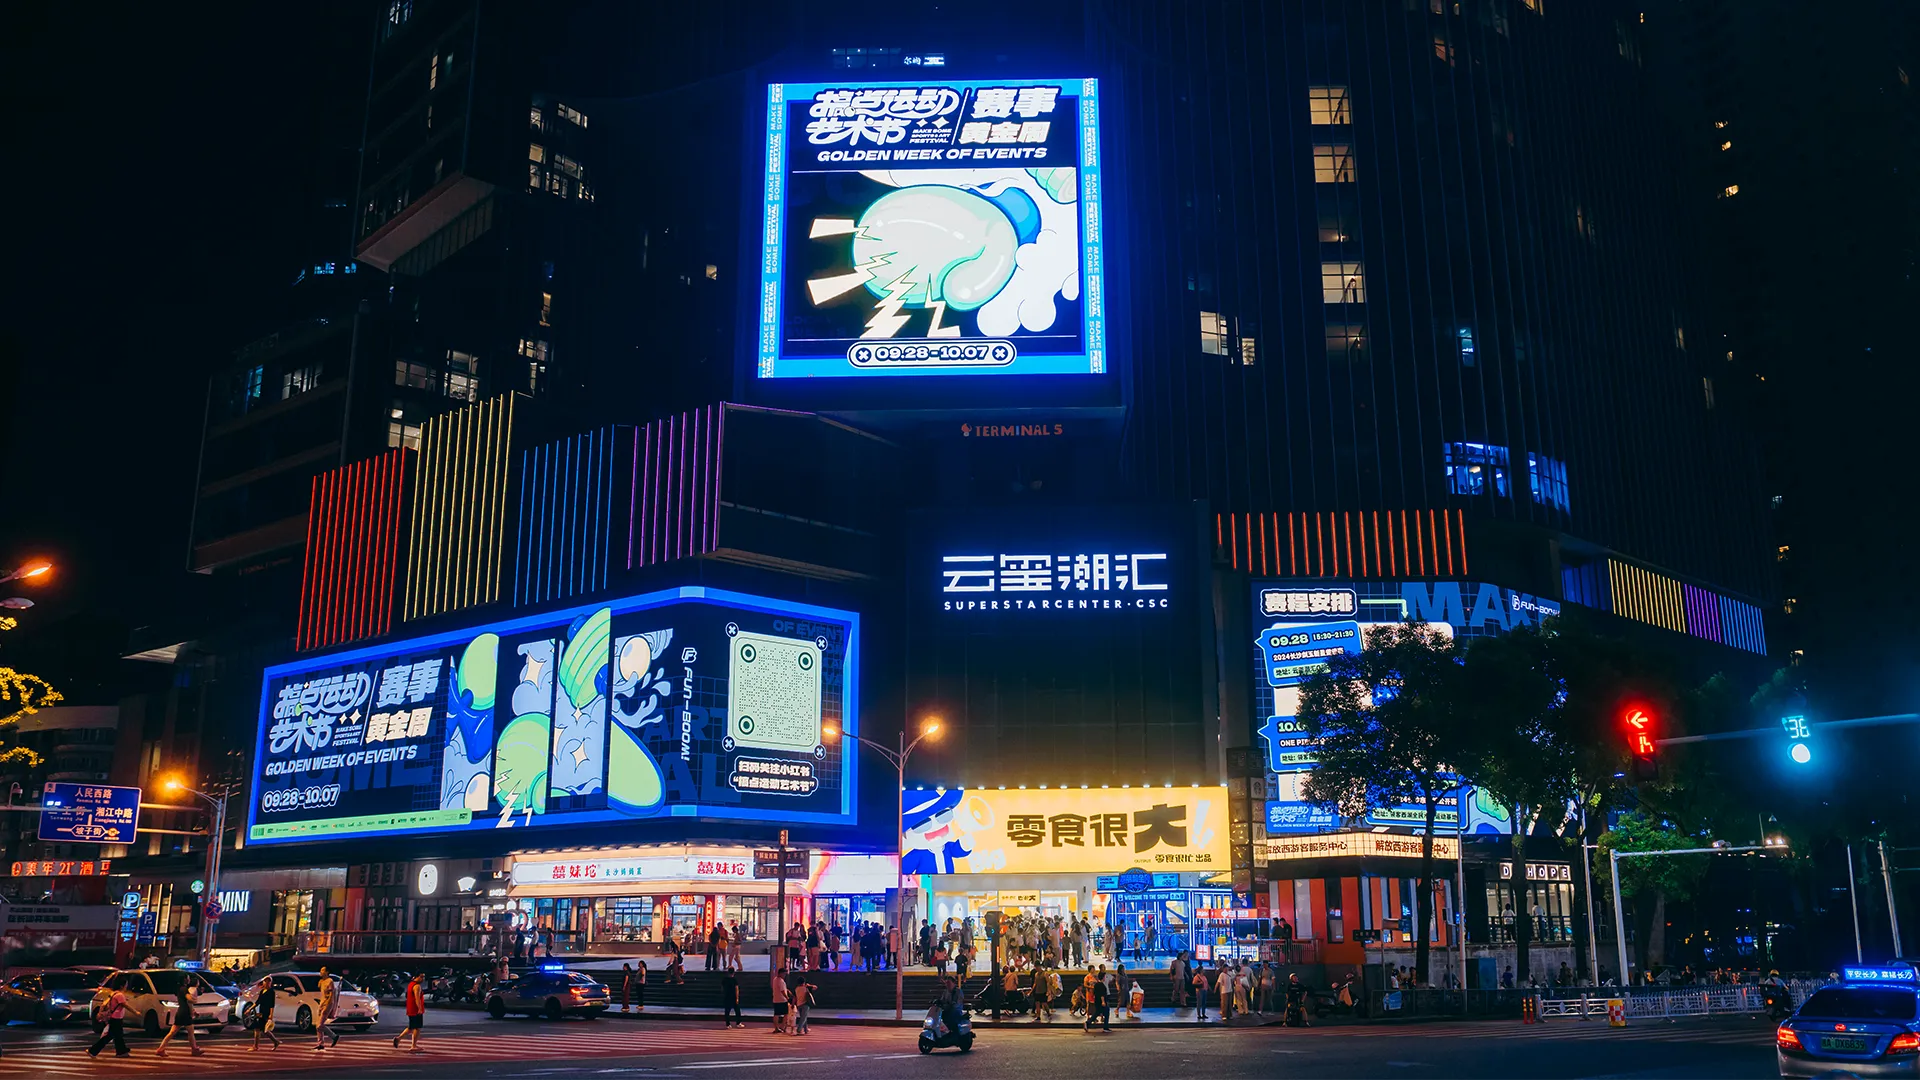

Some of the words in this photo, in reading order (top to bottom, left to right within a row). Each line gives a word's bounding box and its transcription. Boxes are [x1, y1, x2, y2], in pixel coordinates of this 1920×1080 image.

[971, 88, 1058, 118] 赛事
[958, 122, 1050, 144] 黄金周
[817, 150, 894, 161] GOLDEN
[894, 149, 945, 160] WEEK
[946, 149, 972, 159] OF
[973, 148, 1047, 159] EVENTS
[875, 346, 988, 361] 09.28-10.07
[976, 425, 1050, 437] TERMINAL
[1264, 593, 1353, 612] 赛程安排
[1270, 634, 1308, 647] 09.28
[377, 658, 443, 708] 赛事
[365, 707, 433, 744] 黄金周
[266, 759, 311, 776] GOLDEN
[312, 754, 344, 770] WEEK
[346, 752, 364, 767] OF
[362, 745, 418, 763] EVENTS
[75, 788, 112, 799] 人民西路
[263, 786, 339, 808] 09.28-10.07
[96, 807, 133, 818] 湘江中路
[76, 827, 102, 835] 坡子街
[1376, 840, 1449, 855] 解放西游客服中心
[1195, 853, 1212, 863] 出品
[1528, 868, 1567, 877] HOPE
[218, 891, 250, 912] MINI
[1847, 970, 1877, 978] 平安长沙
[1882, 971, 1913, 980] 幸福长沙
